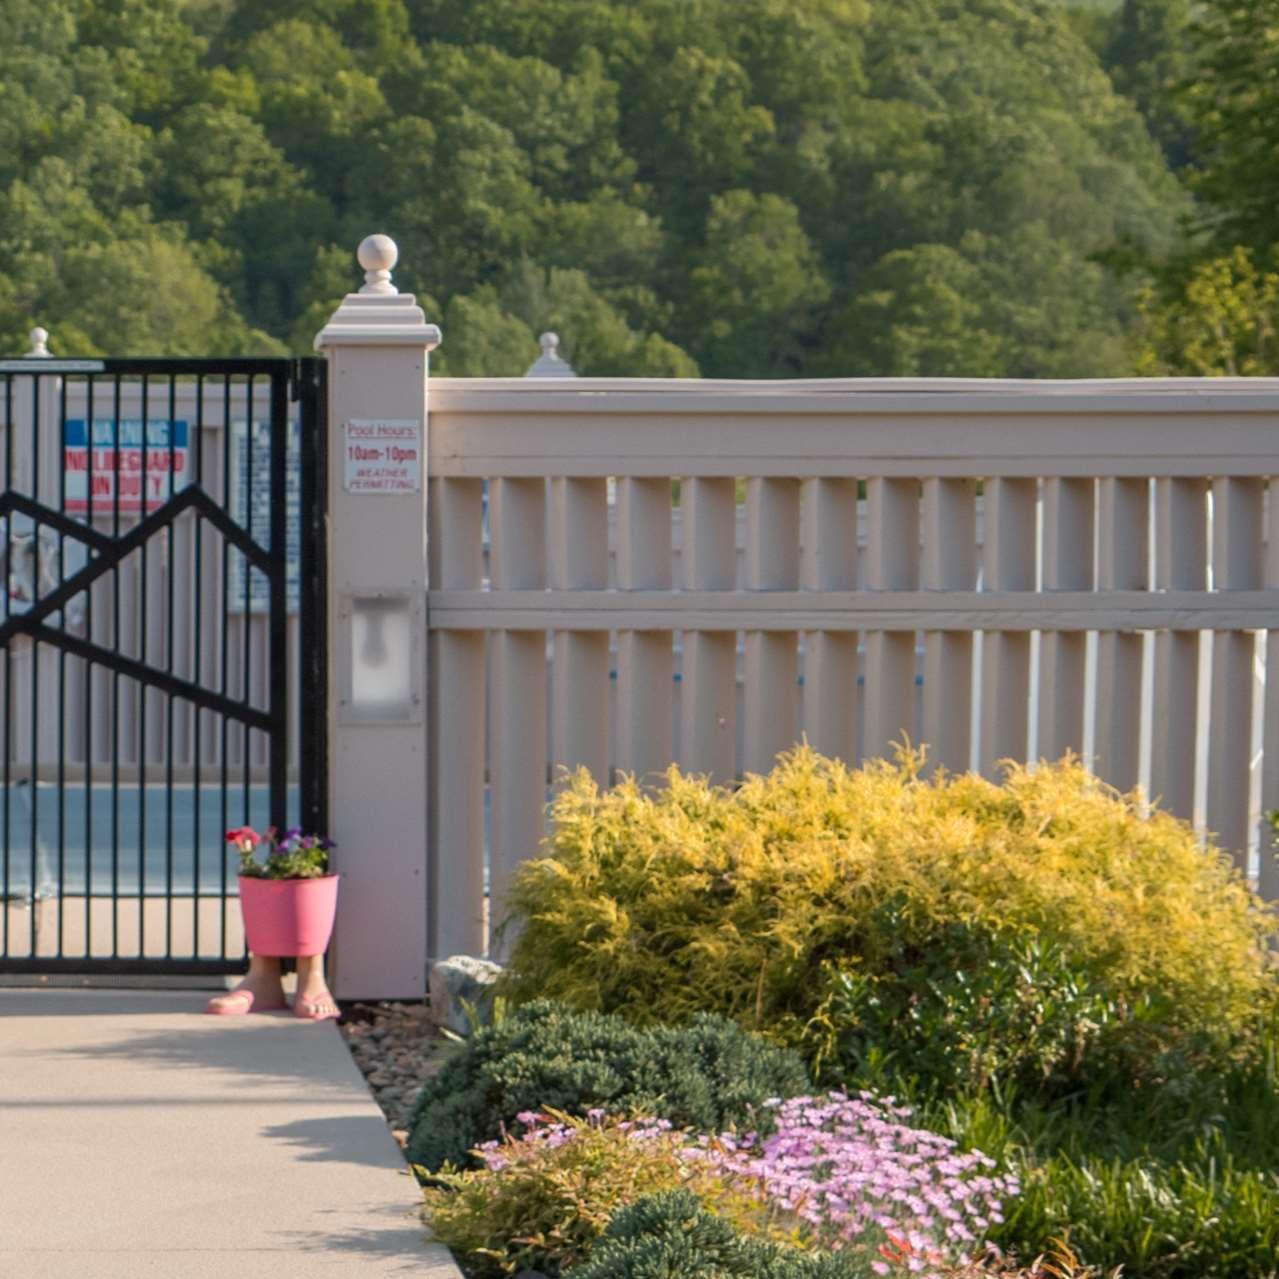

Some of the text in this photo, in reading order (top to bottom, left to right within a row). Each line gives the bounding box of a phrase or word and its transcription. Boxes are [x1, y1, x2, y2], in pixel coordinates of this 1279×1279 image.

[348, 423, 373, 436] Pool
[348, 445, 417, 463] 10am-10pm
[118, 476, 161, 495] DUY
